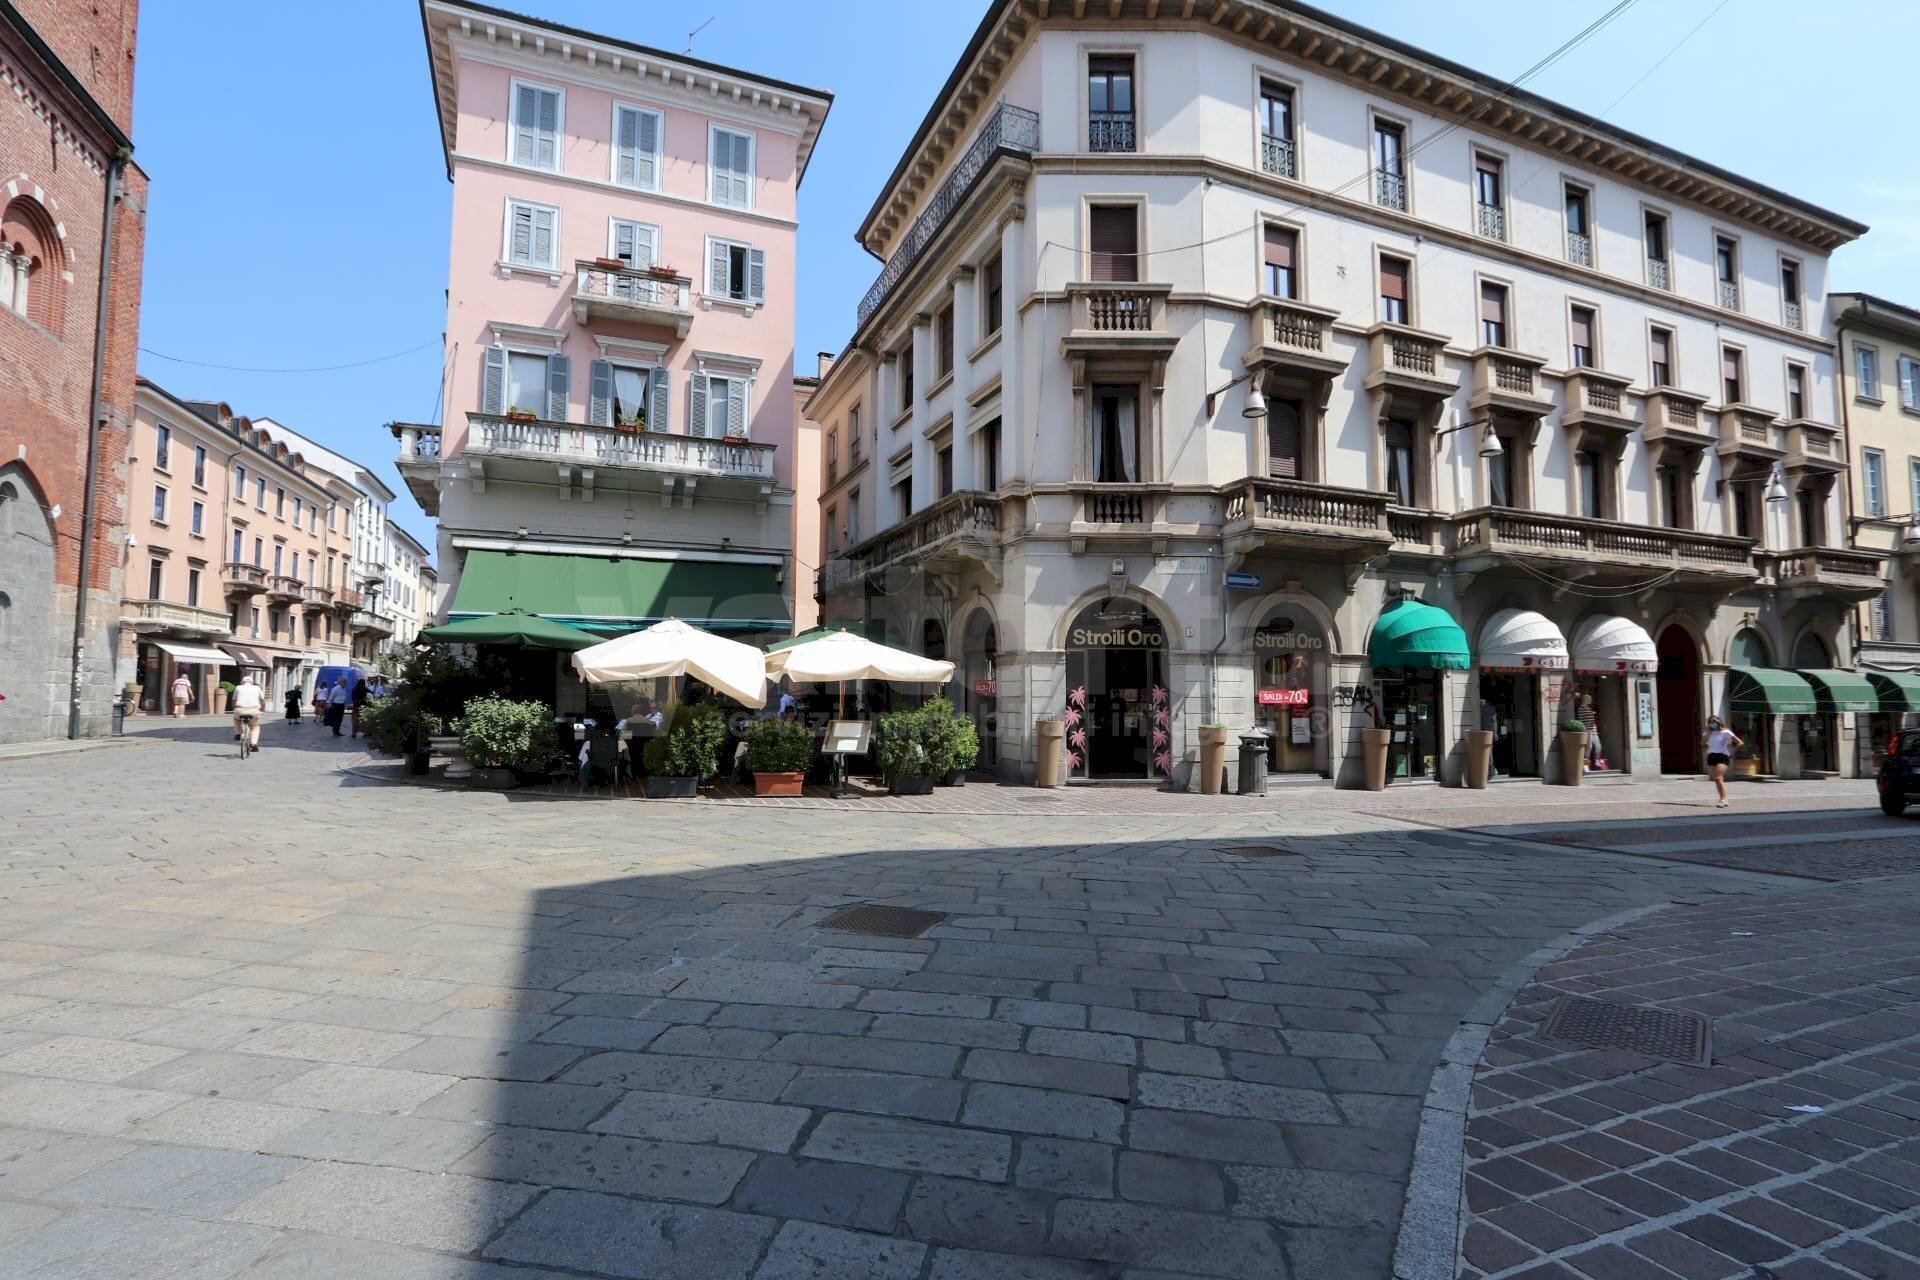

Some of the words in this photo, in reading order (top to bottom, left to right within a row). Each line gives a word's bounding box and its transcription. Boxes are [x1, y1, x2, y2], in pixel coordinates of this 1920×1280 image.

[1073, 628, 1125, 646] Stroili
[1127, 629, 1162, 646] Oro
[1255, 632, 1295, 649] Stroili
[1297, 633, 1322, 649] Oro
[1263, 692, 1283, 701] SALDI
